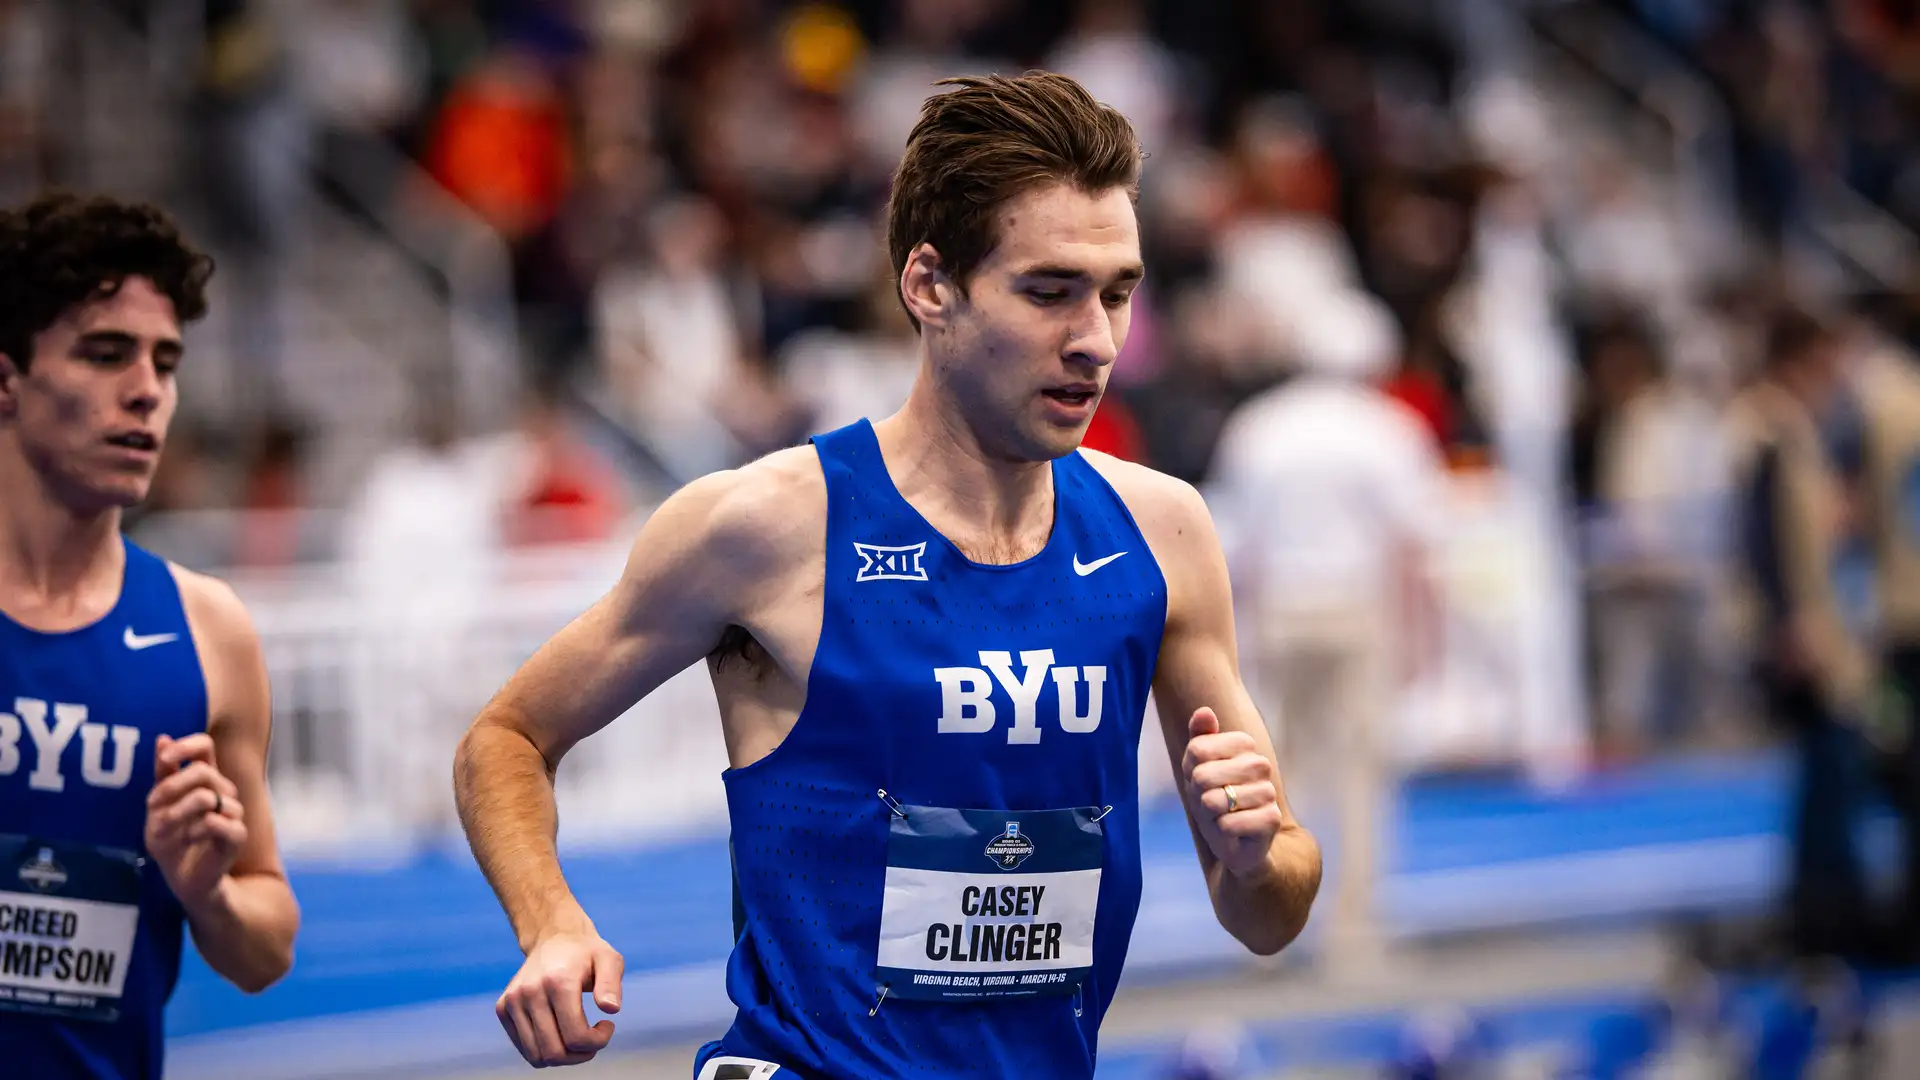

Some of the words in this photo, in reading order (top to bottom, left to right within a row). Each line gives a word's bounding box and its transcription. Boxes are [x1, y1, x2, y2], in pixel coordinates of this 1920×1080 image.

[933, 648, 1107, 745] BYU
[986, 847, 1033, 855] CHAMPIONSHIPS
[961, 885, 1046, 917] CASEY
[0, 903, 78, 939] CREED
[926, 922, 1062, 962] CLINGER
[0, 940, 115, 985] MPSON
[913, 974, 952, 986] VIRGINIA
[952, 976, 981, 987] BEACH,
[983, 976, 1015, 986] VIRGINIA
[1020, 974, 1048, 984] MARCH
[1048, 973, 1067, 983] 14-15
